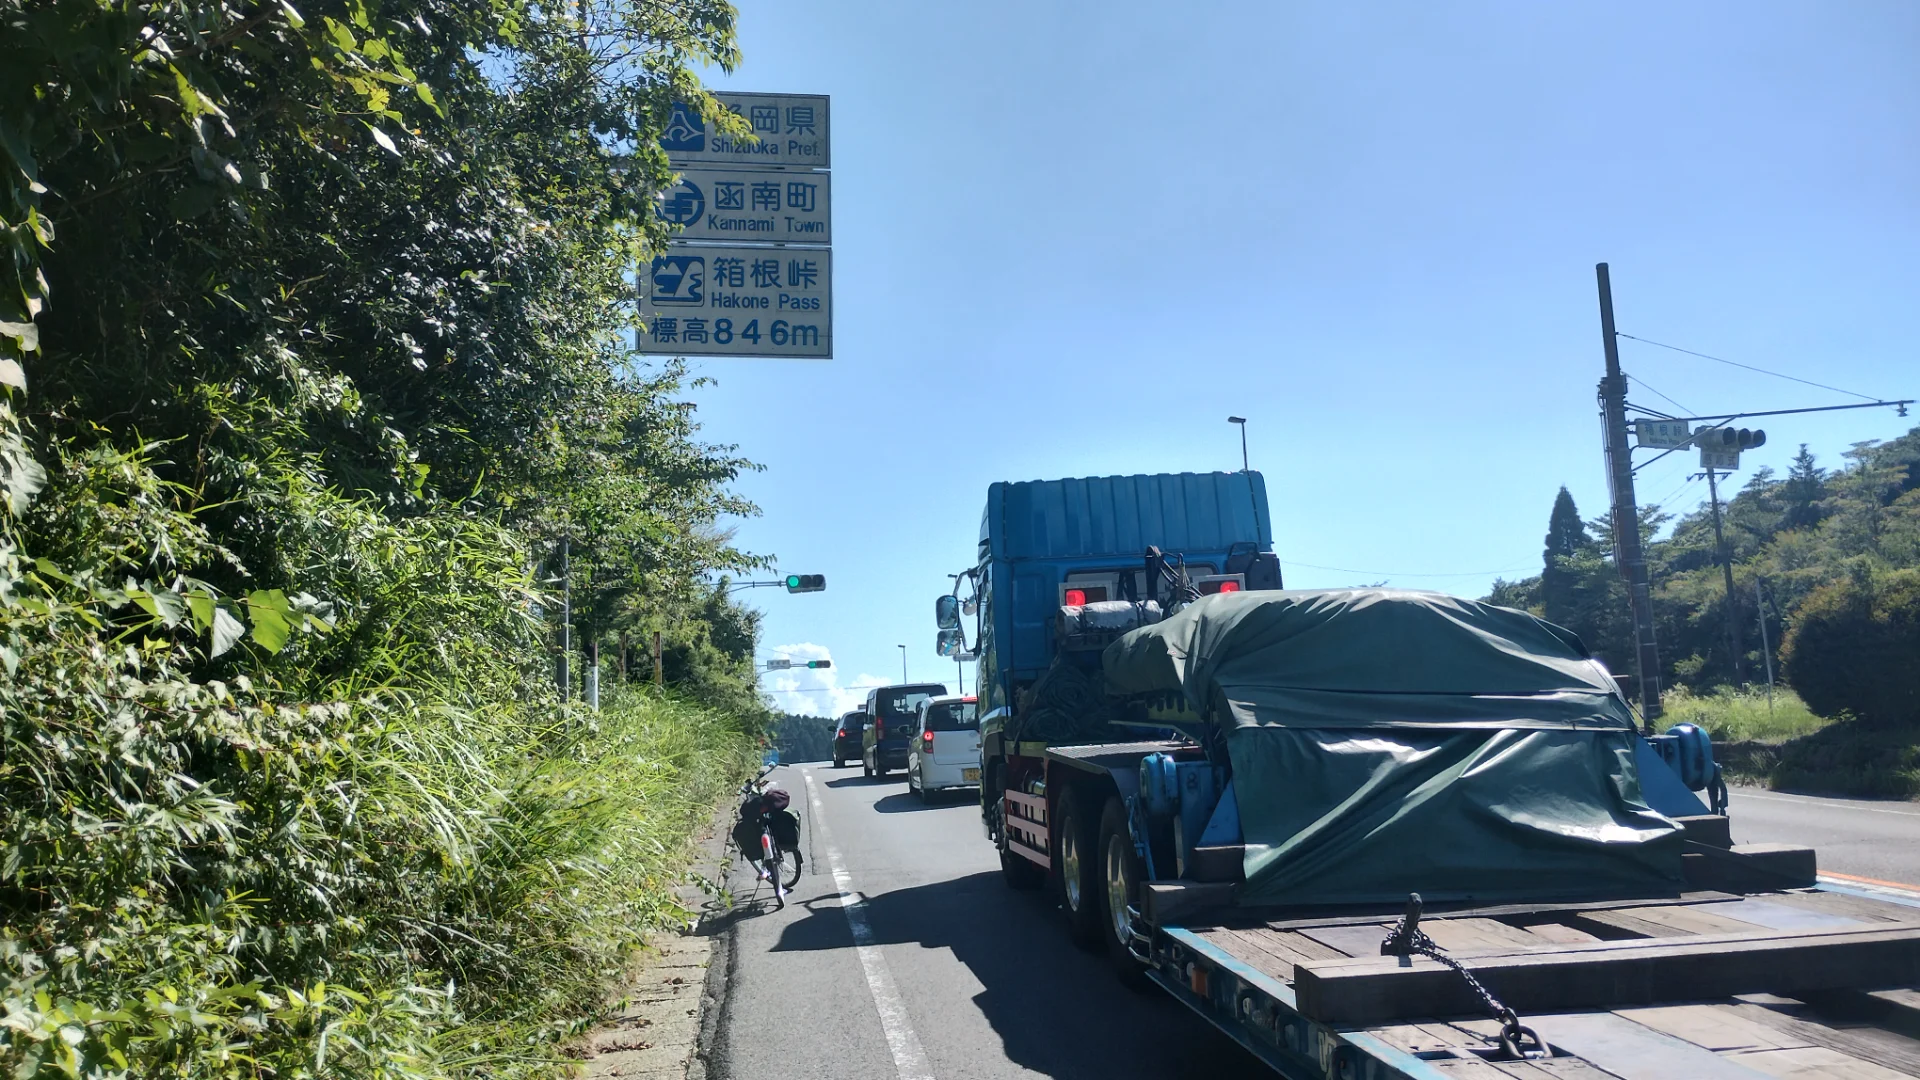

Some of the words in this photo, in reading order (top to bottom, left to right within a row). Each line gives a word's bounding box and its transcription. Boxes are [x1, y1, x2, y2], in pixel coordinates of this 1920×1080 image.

[714, 103, 816, 136] 岡県
[788, 140, 821, 156] Pref.
[714, 181, 818, 213] 函南町
[708, 214, 775, 232] Kannami
[785, 216, 824, 233] Town
[713, 257, 819, 289] 箱根峠
[711, 292, 769, 309] Hakone
[778, 294, 820, 310] Pass
